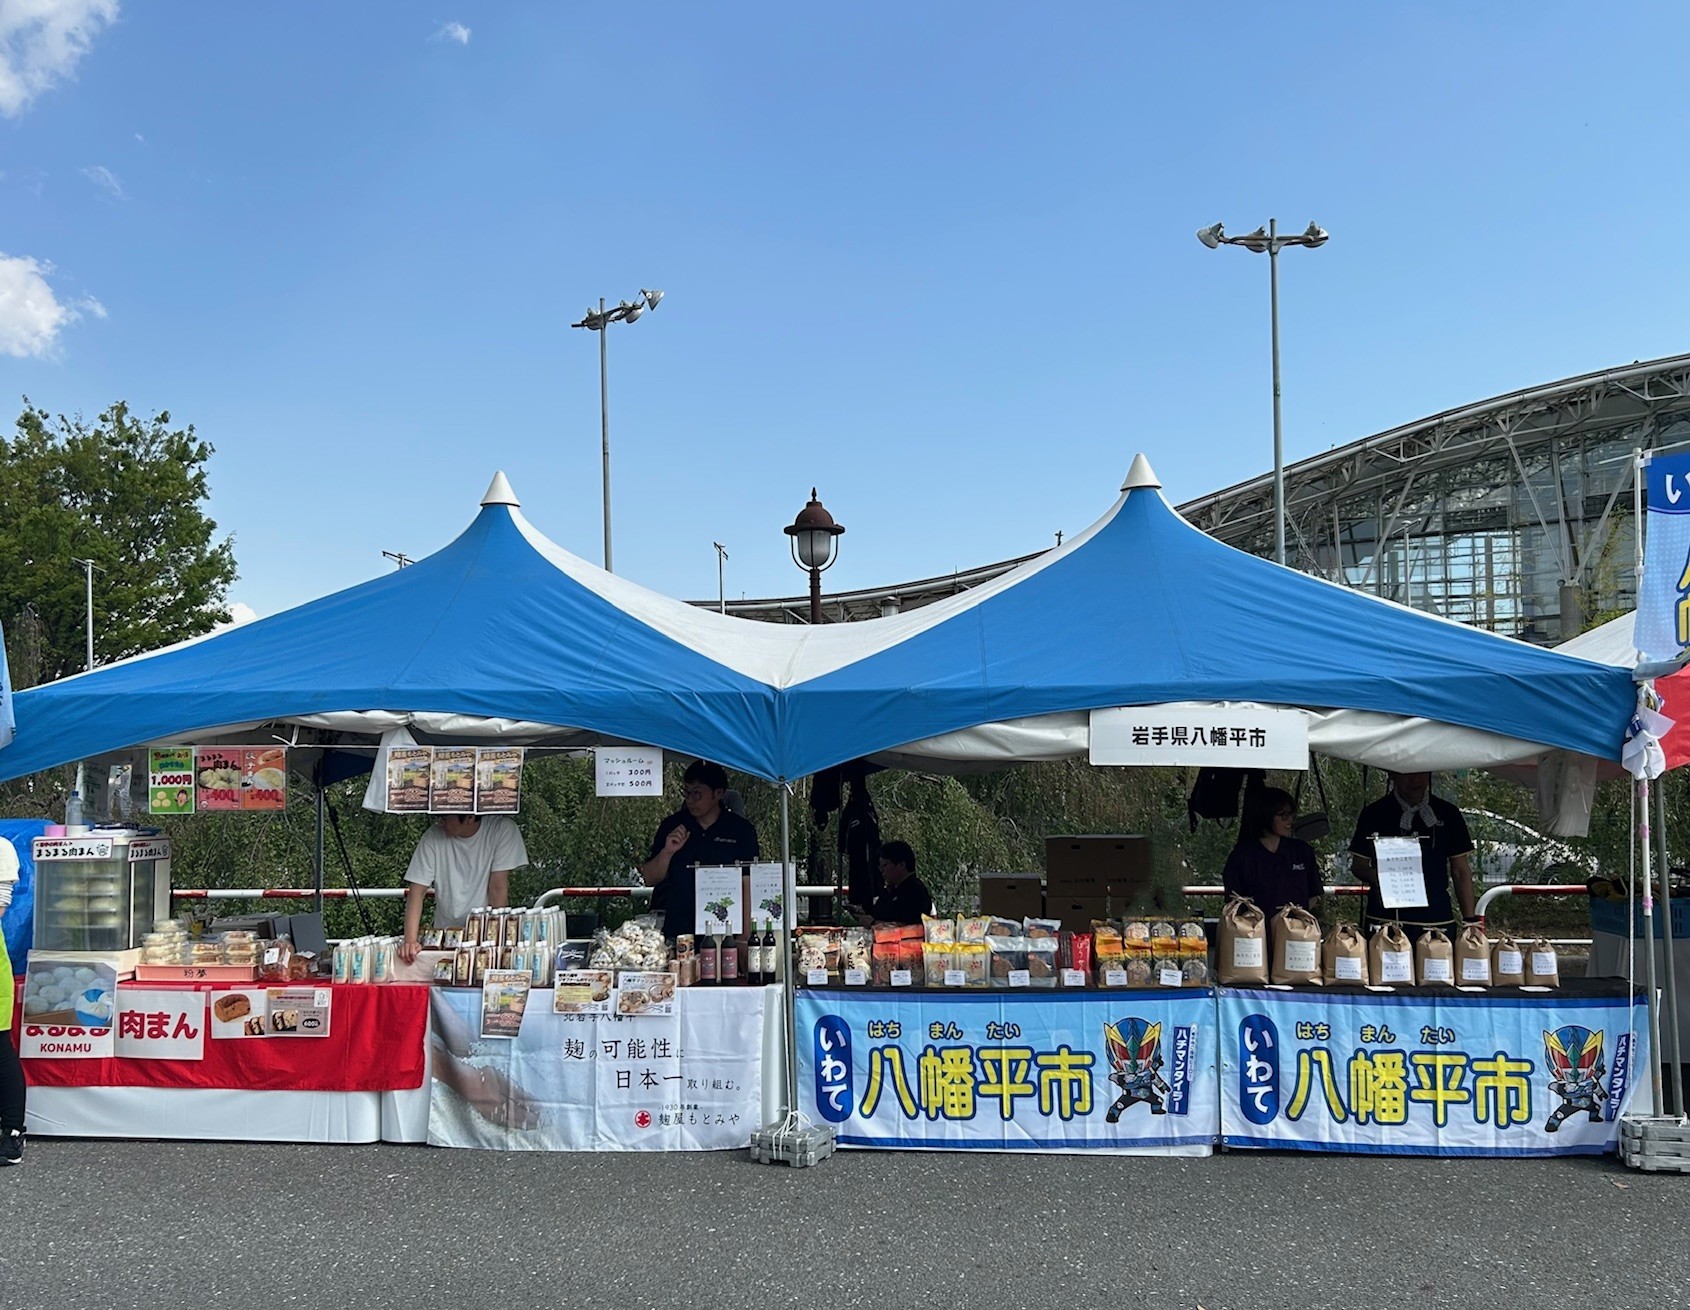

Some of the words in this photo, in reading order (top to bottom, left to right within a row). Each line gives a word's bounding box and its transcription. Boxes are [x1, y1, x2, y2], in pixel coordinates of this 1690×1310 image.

[1131, 725, 1267, 748] 岩手県八幡平市
[213, 760, 239, 770] 肉まん
[151, 774, 192, 786] 1,000円
[36, 847, 95, 858] まるまる肉まん
[119, 1010, 198, 1040] 肉まん
[868, 1021, 902, 1038] はち
[929, 1022, 963, 1039] まん
[986, 1021, 1020, 1039] たい
[1296, 1021, 1331, 1040] はち
[1360, 1025, 1396, 1043] まん
[1421, 1026, 1456, 1044] たい
[40, 1043, 92, 1053] KONAMU
[563, 1038, 685, 1060] 麹の可能性に
[616, 1068, 742, 1091] 日本一取り組む。
[819, 1026, 848, 1112] いわて
[1172, 1029, 1188, 1112] ハチマンタイラー
[1243, 1027, 1274, 1114] いわて
[1610, 1036, 1627, 1120] ハチマンタイラー
[859, 1044, 1096, 1121] 八幡平市
[1285, 1047, 1535, 1129] 八幡平市
[658, 1112, 740, 1126] 麹屋もとみや
